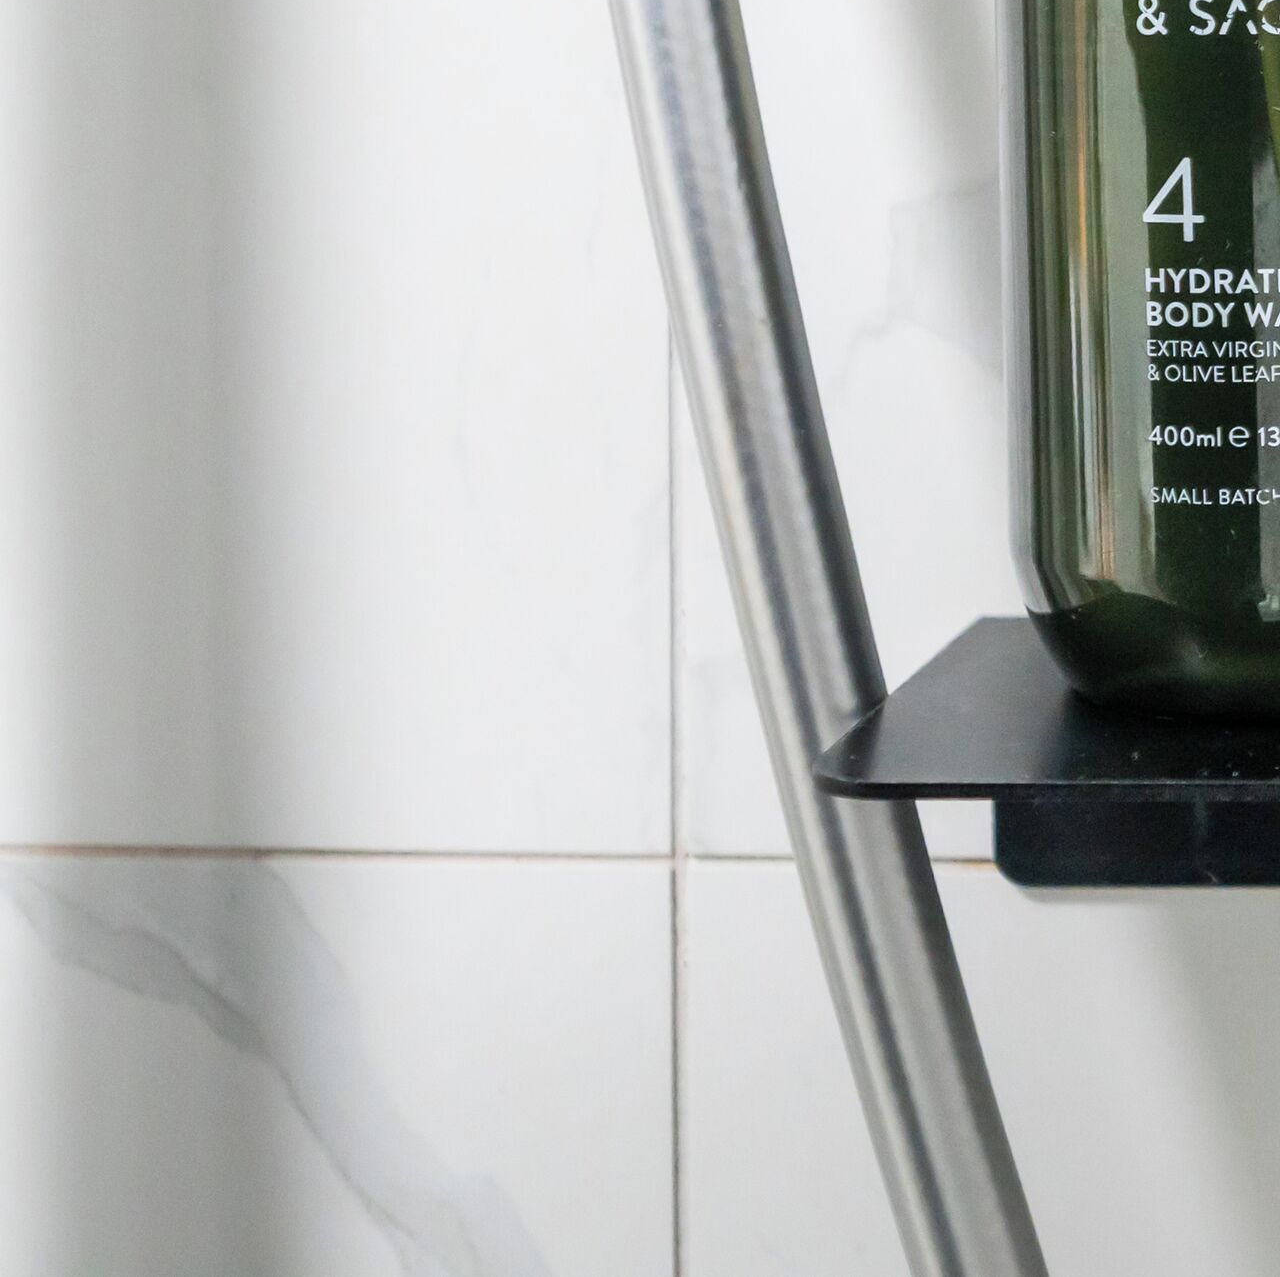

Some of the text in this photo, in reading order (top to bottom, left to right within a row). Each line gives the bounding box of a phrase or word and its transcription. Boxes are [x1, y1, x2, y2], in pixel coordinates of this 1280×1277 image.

[1142, 157, 1203, 242] 4
[1146, 301, 1234, 326] BODY
[1146, 338, 1207, 356] EXTRA
[1147, 363, 1159, 380] &
[1164, 364, 1225, 382] OLIVE
[1231, 364, 1280, 382] LEAF
[1148, 425, 1221, 446] 400ml
[1150, 487, 1212, 504] SMALL
